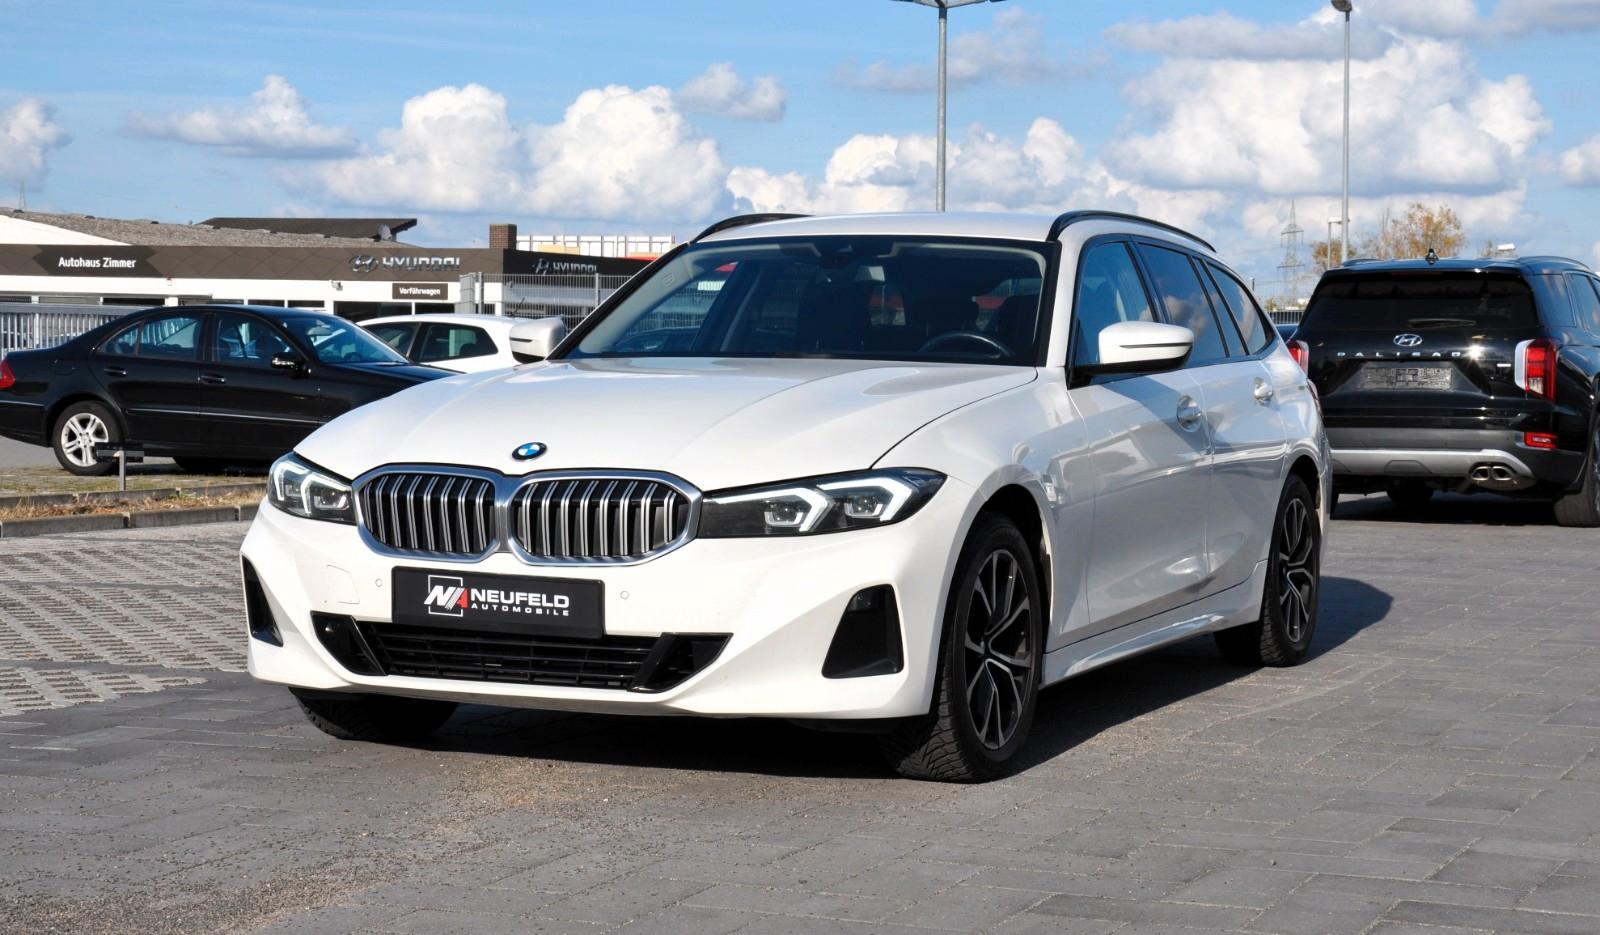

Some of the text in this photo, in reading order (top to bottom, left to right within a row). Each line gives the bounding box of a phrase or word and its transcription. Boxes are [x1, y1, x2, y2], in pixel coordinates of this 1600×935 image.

[58, 256, 137, 268] Autohaus Zimmer
[382, 256, 461, 272] HYUNDAI
[399, 287, 441, 296] Vorführwagen
[470, 588, 569, 608] NEUFELD
[470, 602, 569, 616] AUTOMOBILE
